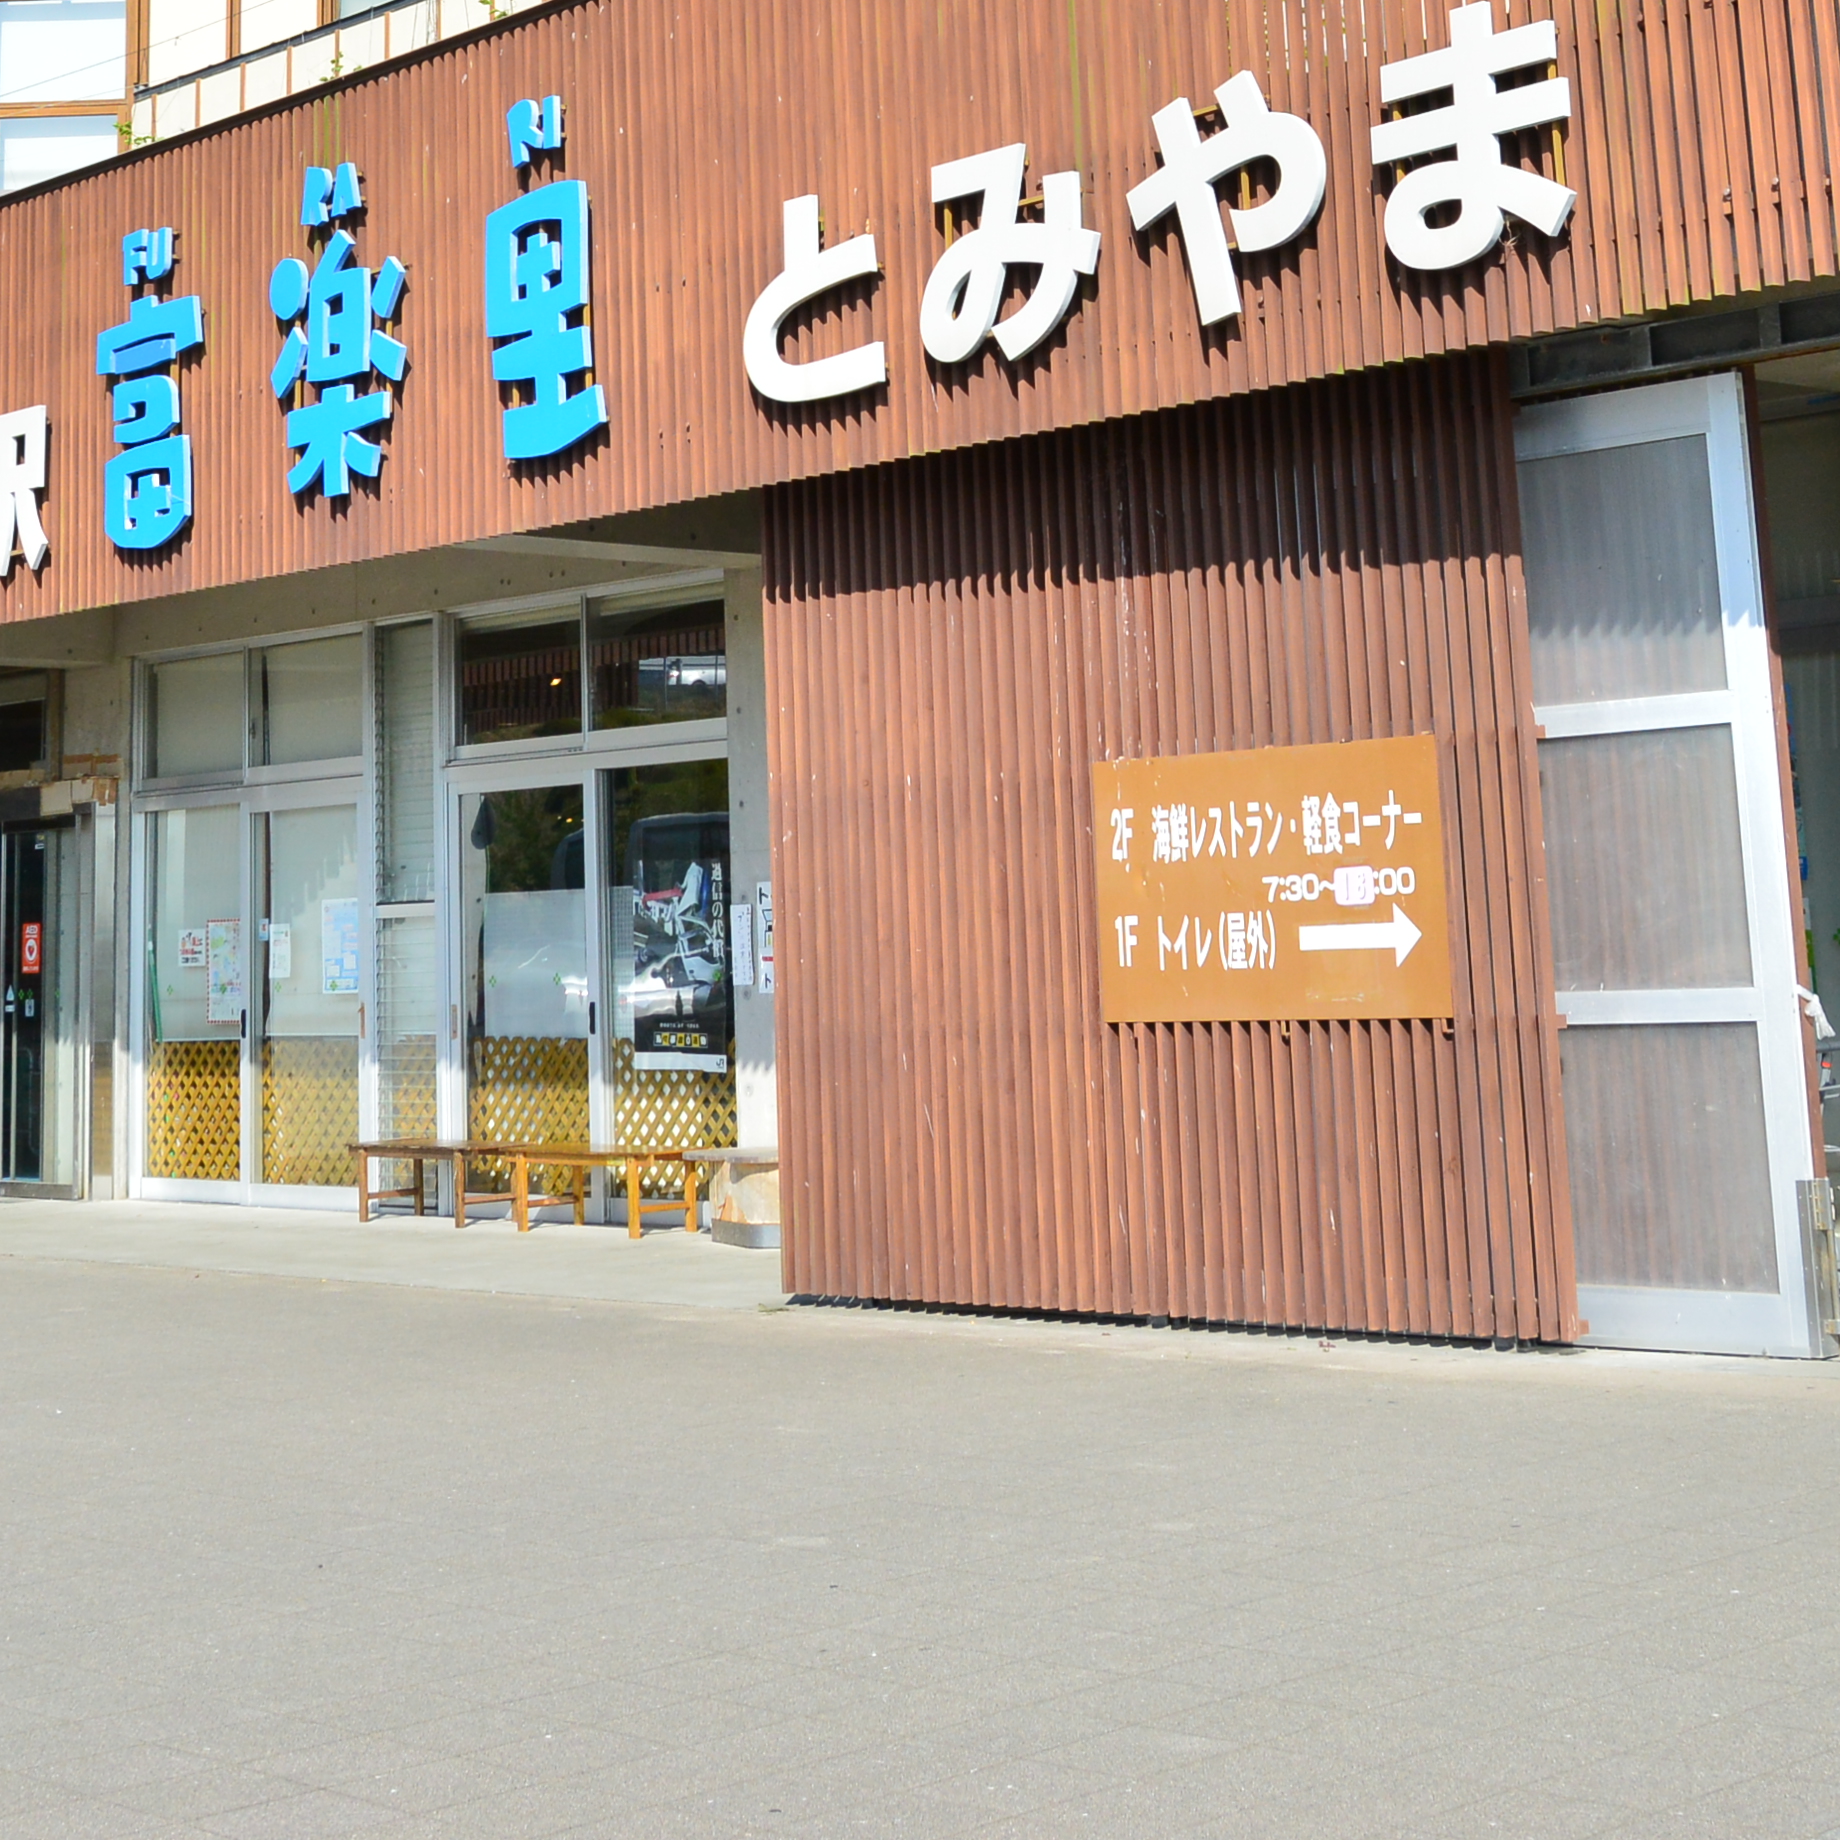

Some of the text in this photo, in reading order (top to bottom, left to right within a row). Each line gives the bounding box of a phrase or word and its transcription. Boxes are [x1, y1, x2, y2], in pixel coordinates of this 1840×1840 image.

[122, 94, 561, 286] FU RA RI
[743, 0, 1577, 405] とみやま
[1110, 789, 1422, 864] 2F 海鮮レストラン・軽食コーナー
[1114, 914, 1139, 968] 1F
